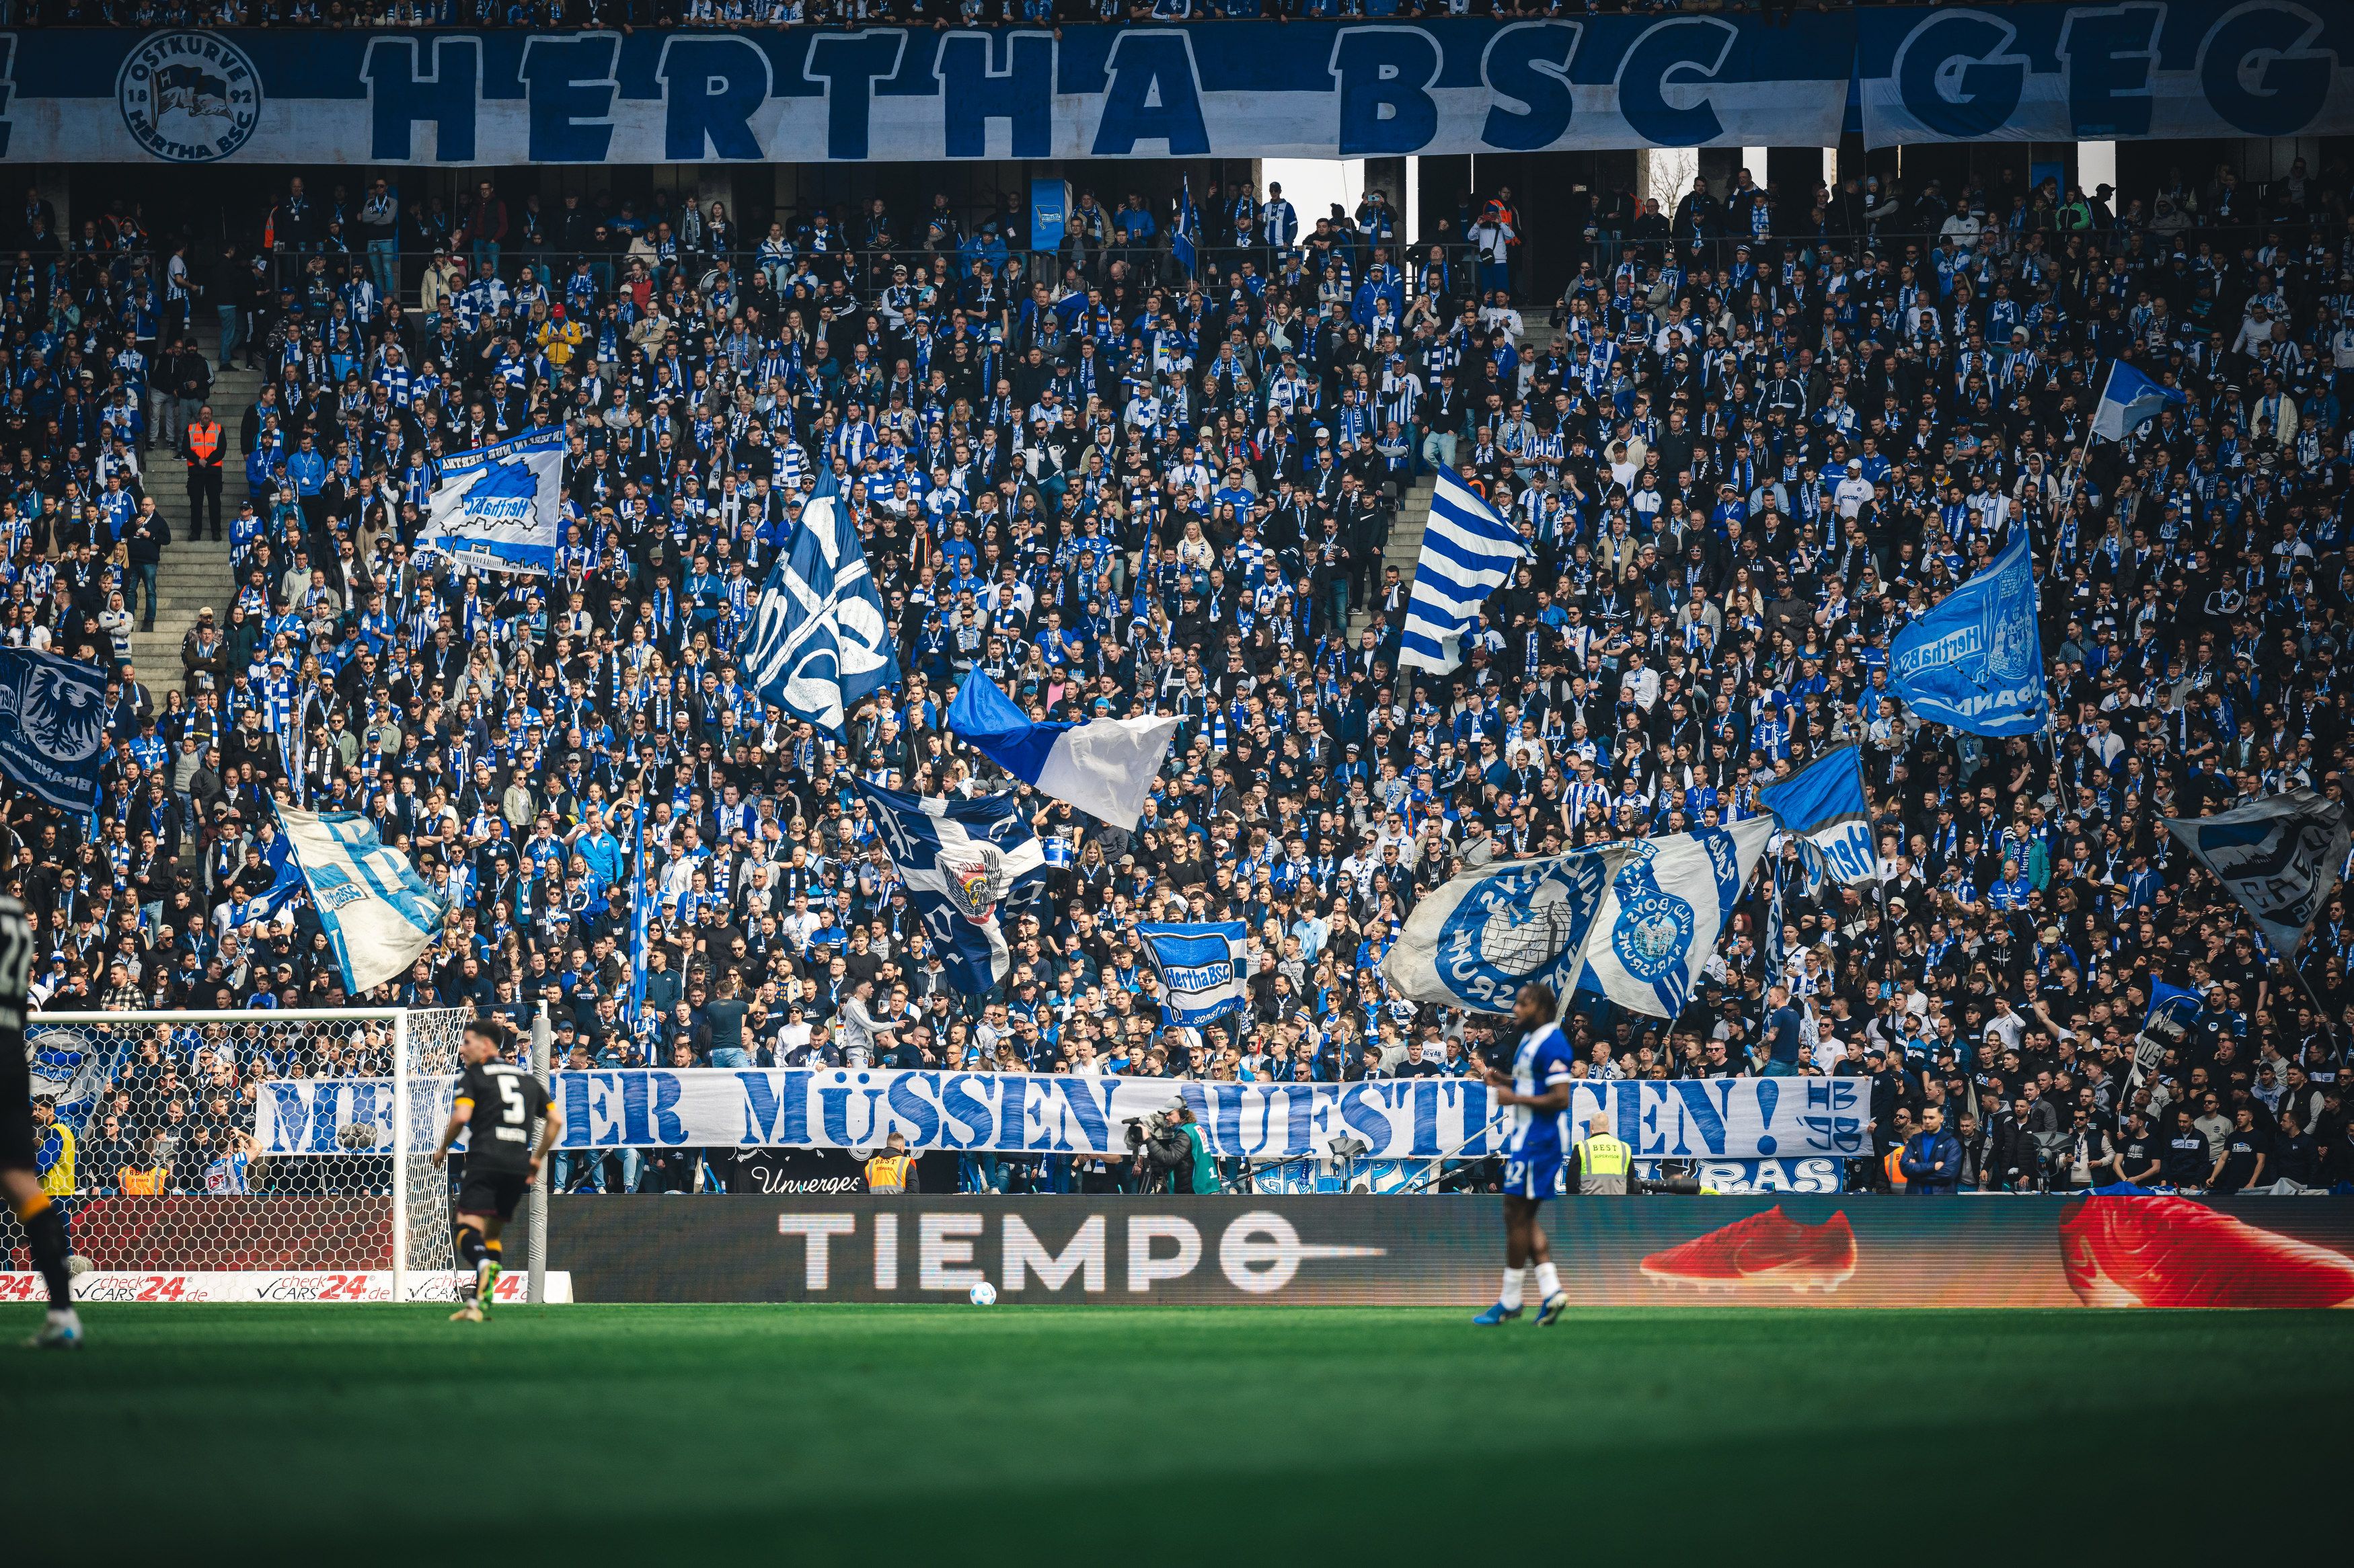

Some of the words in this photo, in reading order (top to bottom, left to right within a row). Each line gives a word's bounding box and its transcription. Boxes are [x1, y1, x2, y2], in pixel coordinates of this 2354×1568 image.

[131, 36, 248, 82] OSTKURVE
[128, 89, 147, 102] 18
[230, 89, 252, 103] 92
[360, 30, 1211, 161] HERTHA
[1328, 18, 1739, 155] BSC
[128, 110, 214, 159] HERTHA
[216, 111, 253, 153] BSC
[1192, 1008, 1221, 1024] sonst
[496, 1074, 525, 1125] 5
[1808, 1080, 1858, 1111] HB
[1593, 1144, 1618, 1152] BEST
[778, 1210, 1301, 1292] TIEMPO
[101, 1275, 145, 1289] check
[282, 1274, 327, 1288] check
[272, 1287, 319, 1300] CARS
